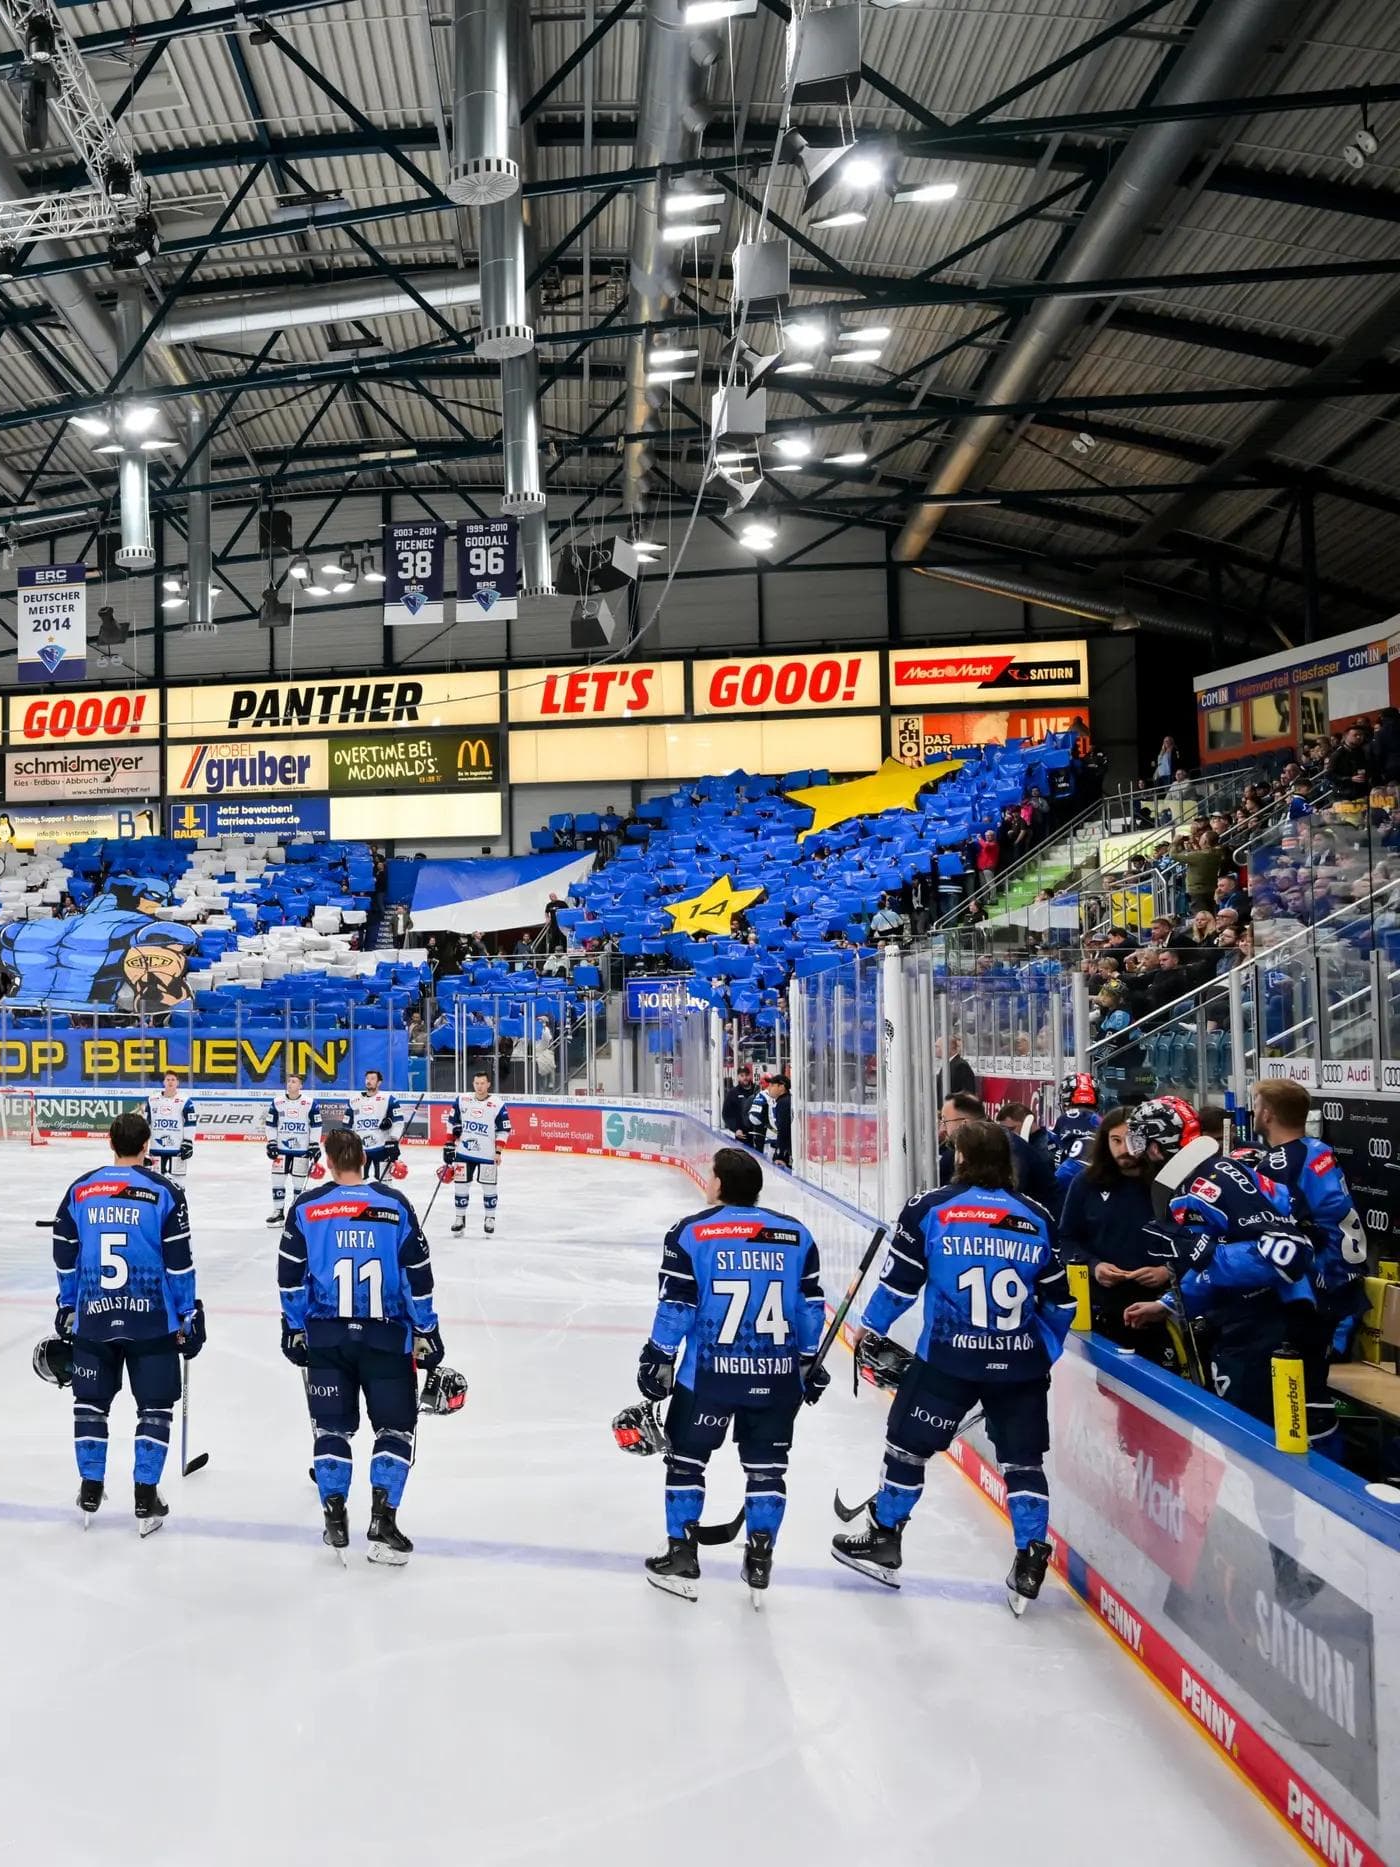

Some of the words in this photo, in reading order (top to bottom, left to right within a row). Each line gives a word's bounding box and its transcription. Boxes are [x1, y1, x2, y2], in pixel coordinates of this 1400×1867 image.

[396, 539, 434, 550] FICENEC
[465, 535, 509, 547] GOODALL
[398, 551, 432, 579] 38
[470, 548, 504, 575] 96
[35, 569, 67, 580] ERC
[23, 591, 80, 603] DEUTSCHER
[29, 604, 75, 615] MEISTER
[33, 617, 71, 632] 2014
[1030, 666, 1074, 680] SATURN
[1292, 661, 1341, 683] Glasfaser
[540, 668, 654, 714] LET'S
[708, 658, 864, 708] GOOO!
[227, 682, 423, 729] PANTHER
[24, 695, 146, 739] GOOO!
[925, 735, 951, 744] DAS
[207, 743, 255, 758] MÖBEL
[14, 756, 143, 780] schmidmeyer
[206, 750, 311, 793] gruber
[14, 778, 28, 786] Kies
[34, 777, 61, 786] Erdbau
[66, 776, 98, 784] Abbruch
[217, 804, 240, 815] Jetzt
[241, 803, 293, 814] bewerben!
[217, 815, 300, 827] karriere.bauer.de
[174, 829, 206, 839] BAUER
[84, 1039, 349, 1076] BELIEVIN'
[1290, 1066, 1310, 1081] Audi
[1347, 1066, 1371, 1082] Audi
[540, 1120, 570, 1129] Sparkasse
[540, 1130, 570, 1139] Ingolstadt
[571, 1131, 594, 1140] Eichstätt
[88, 1207, 140, 1226] WAGNER
[336, 1231, 375, 1249] VIRTA
[773, 1231, 797, 1242] SATURN
[941, 1236, 1043, 1264] STACHOWIAK
[100, 1233, 129, 1290] 5
[333, 1258, 383, 1319] 11
[957, 1266, 1029, 1332] 19
[712, 1279, 791, 1346] 74
[714, 1356, 793, 1376] INGOLSTADT
[1288, 1376, 1301, 1439] Powerbar
[910, 1405, 957, 1430] JOOP!
[1253, 1588, 1357, 1739] SATURN
